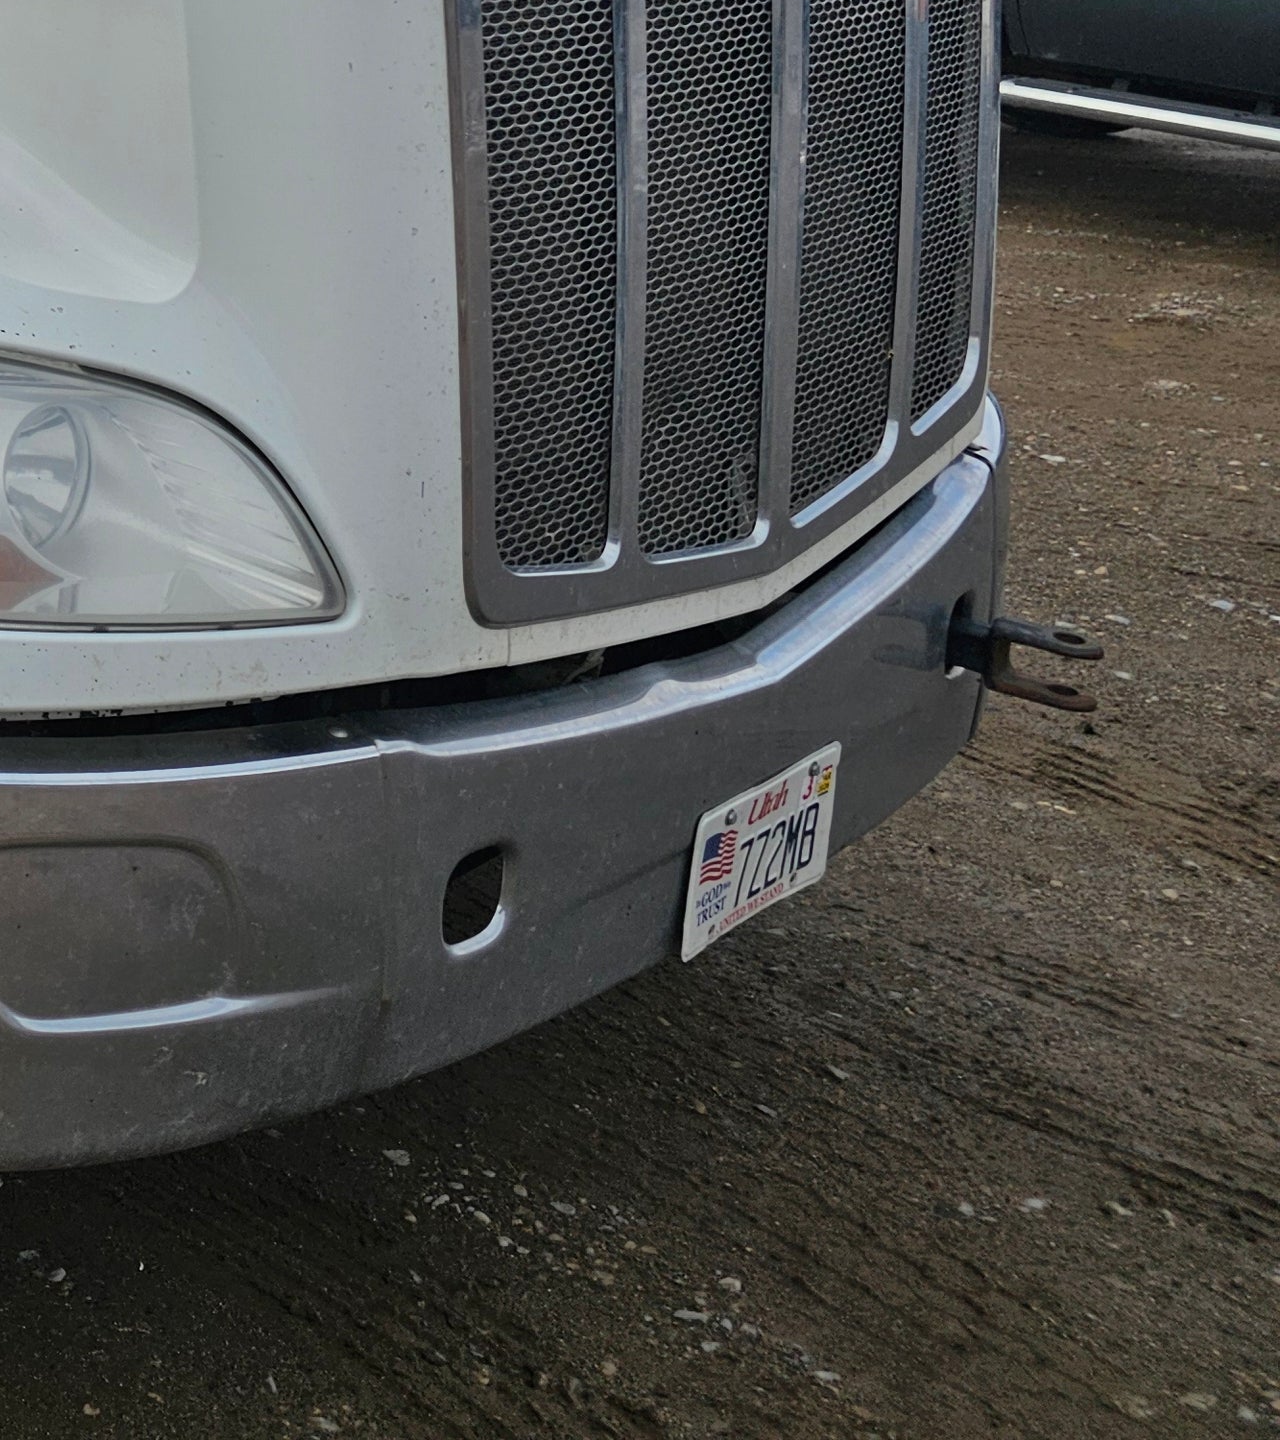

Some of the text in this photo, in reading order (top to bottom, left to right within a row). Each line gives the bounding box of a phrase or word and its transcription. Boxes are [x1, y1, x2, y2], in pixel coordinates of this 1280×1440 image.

[747, 778, 789, 825] Utah
[696, 895, 727, 927] TRUST
[701, 883, 723, 908] GOD
